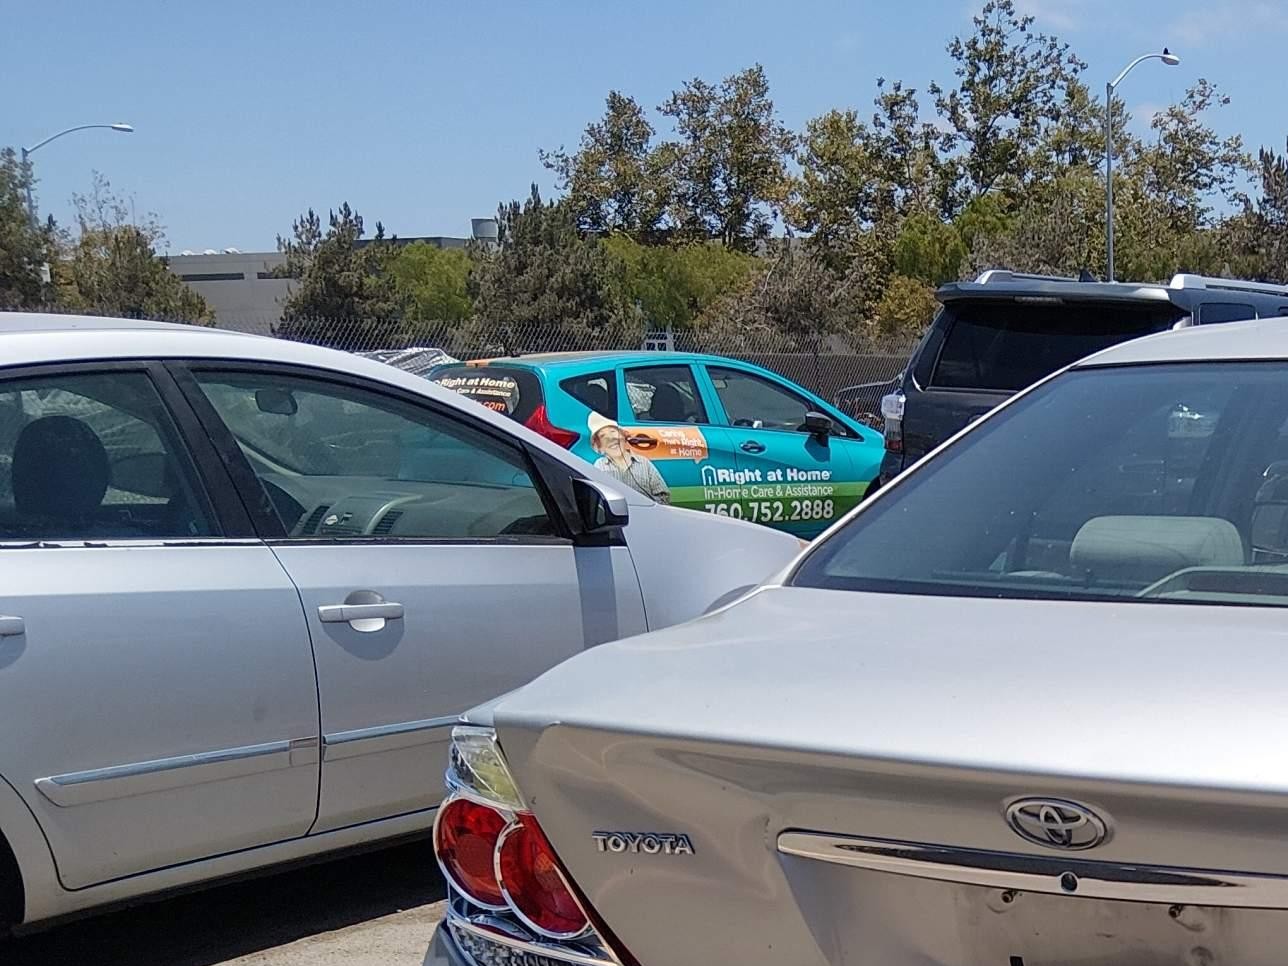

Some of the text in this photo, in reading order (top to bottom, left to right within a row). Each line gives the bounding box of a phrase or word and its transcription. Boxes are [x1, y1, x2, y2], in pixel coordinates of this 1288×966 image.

[480, 377, 515, 389] Home
[717, 468, 830, 484] Right at Home
[704, 484, 833, 500] In-Home Care & Assistance
[592, 831, 695, 855] TOYOTA
